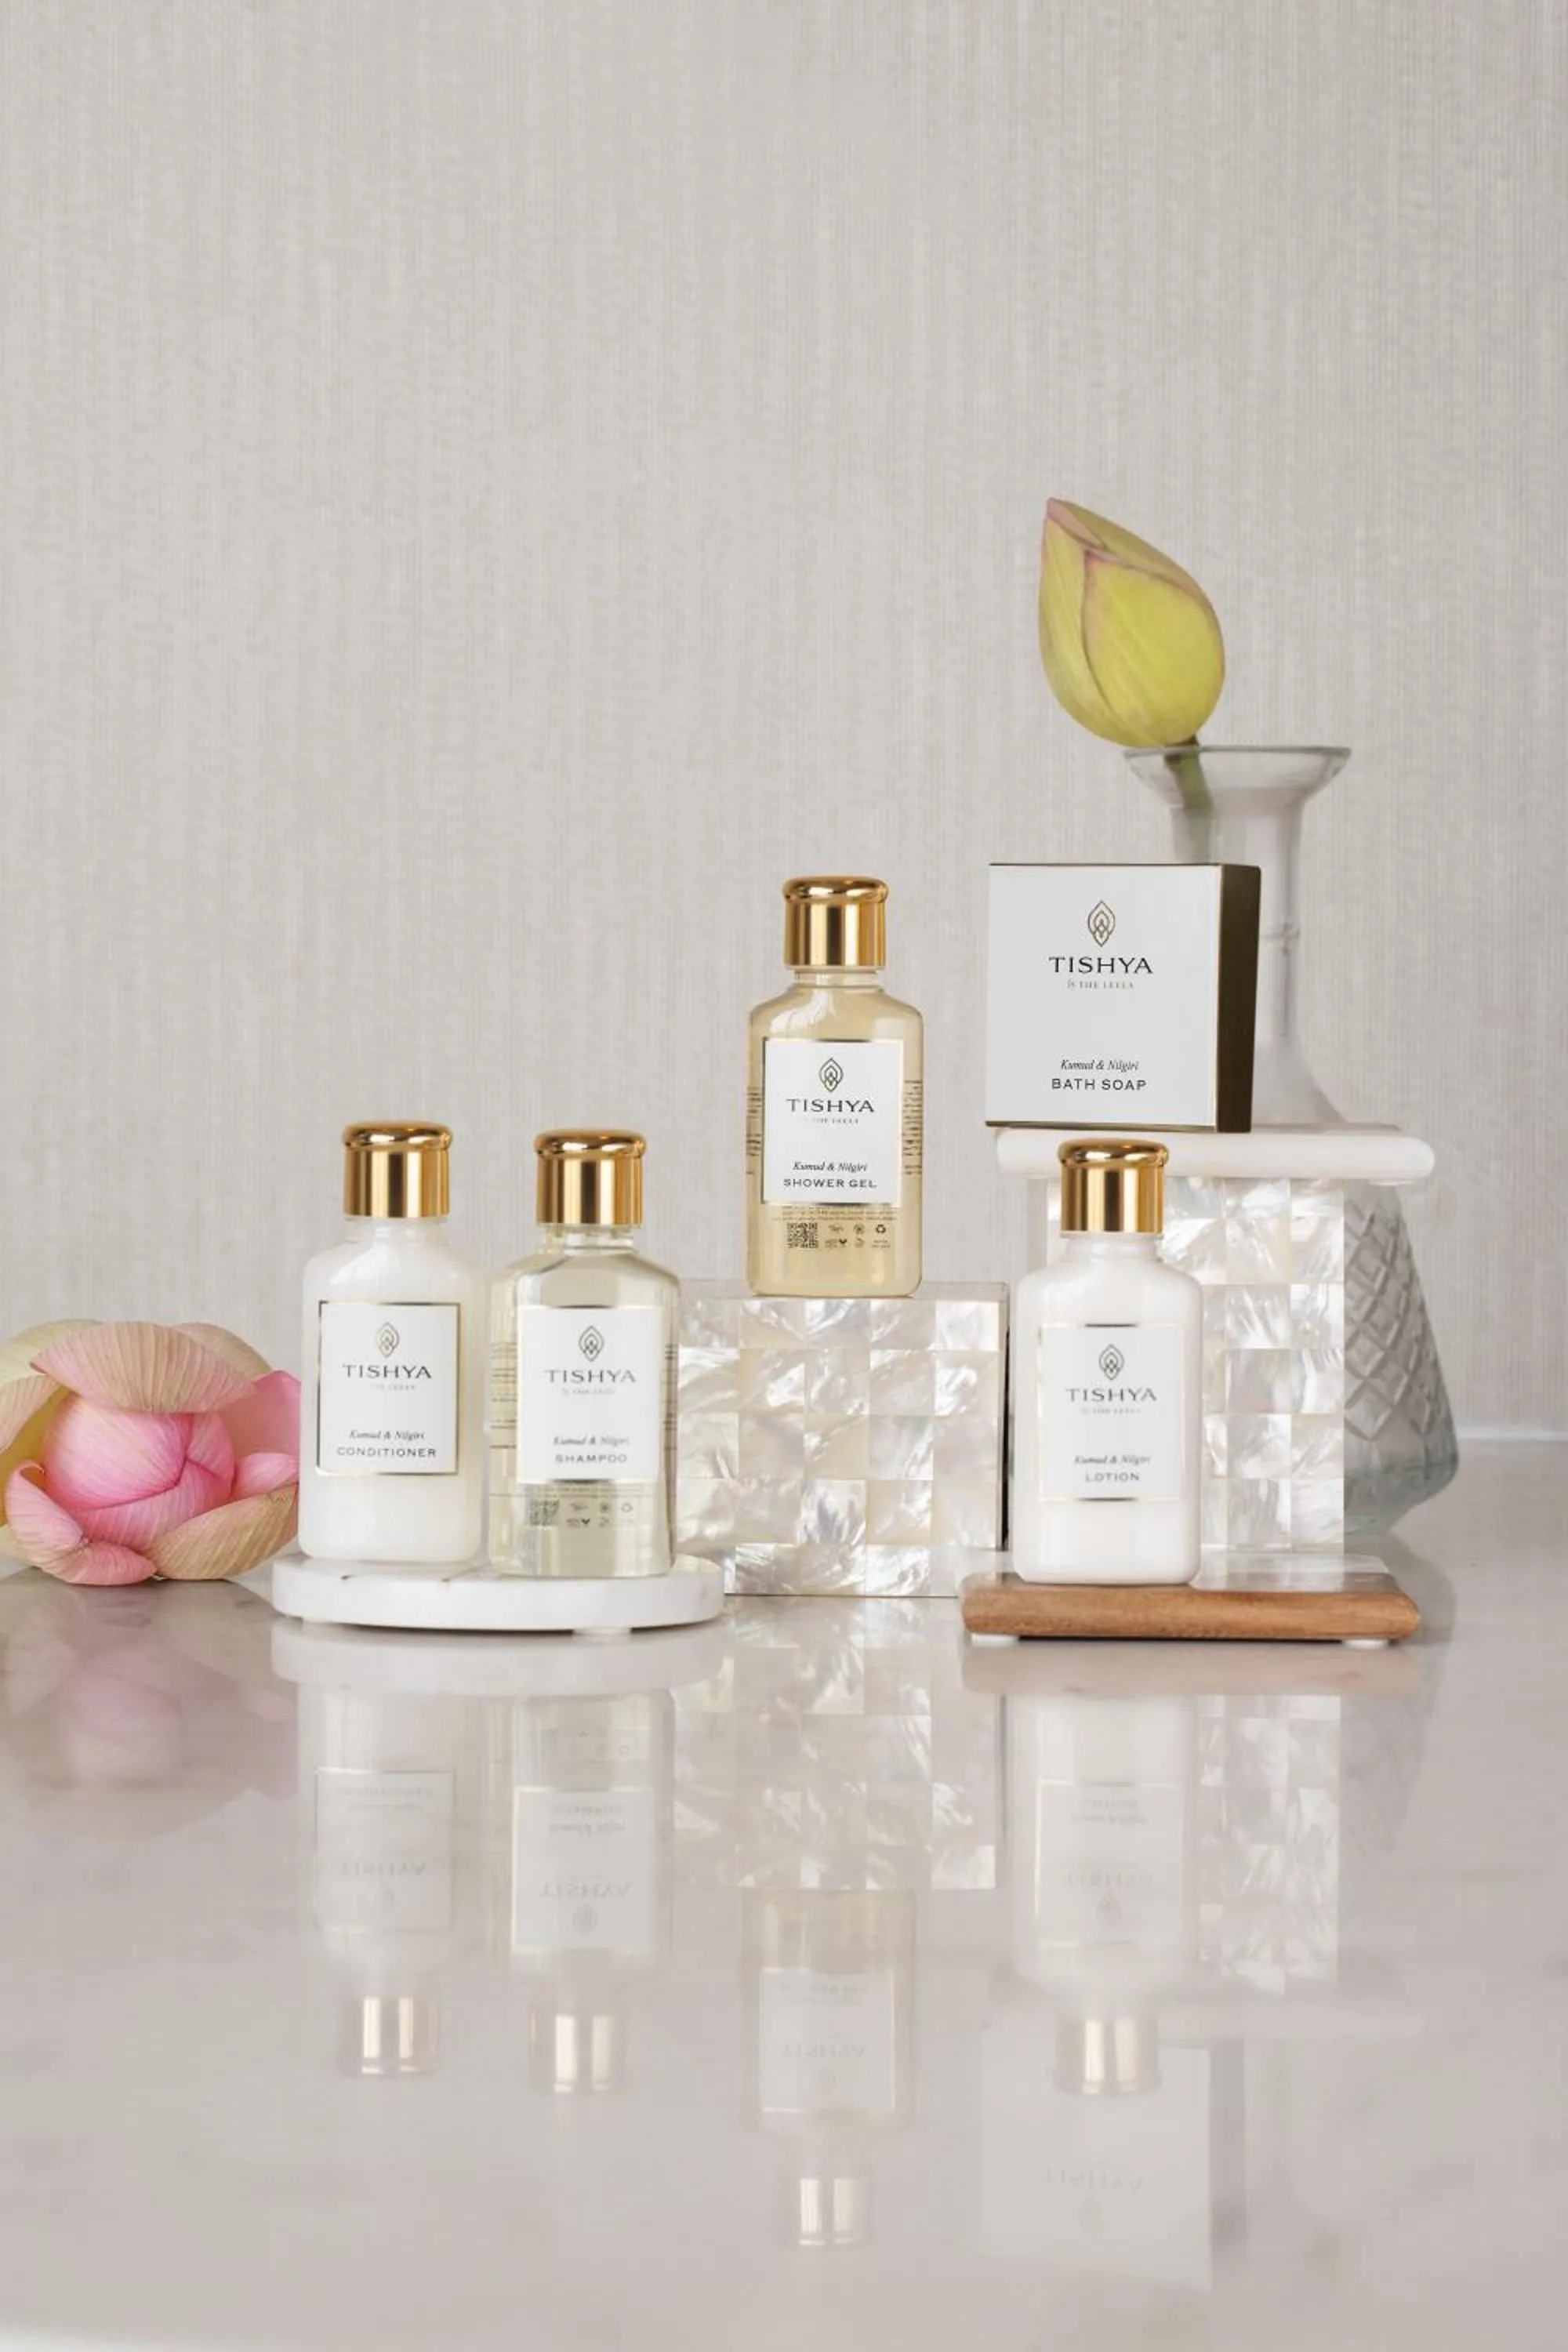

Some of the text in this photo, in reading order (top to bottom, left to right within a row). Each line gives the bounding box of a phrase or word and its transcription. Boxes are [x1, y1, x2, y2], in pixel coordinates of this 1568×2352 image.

[1048, 956, 1153, 975] TISHYA
[1060, 1059, 1139, 1073] Kumud & Nilgiri
[1051, 1078, 1147, 1091] BATH SOAP
[785, 1098, 875, 1113] TISHYA
[793, 1160, 868, 1174] Kumud & Nilgiri
[783, 1178, 877, 1189] SHOWER GEL
[342, 1364, 433, 1380] TISHYA
[544, 1369, 637, 1384] TISHYA
[1065, 1387, 1158, 1403] TISHYA
[383, 1430, 392, 1440] &
[336, 1446, 437, 1458] CONDITIONER
[555, 1454, 627, 1464] SHAMPOO
[1085, 1472, 1140, 1483] LOTION
